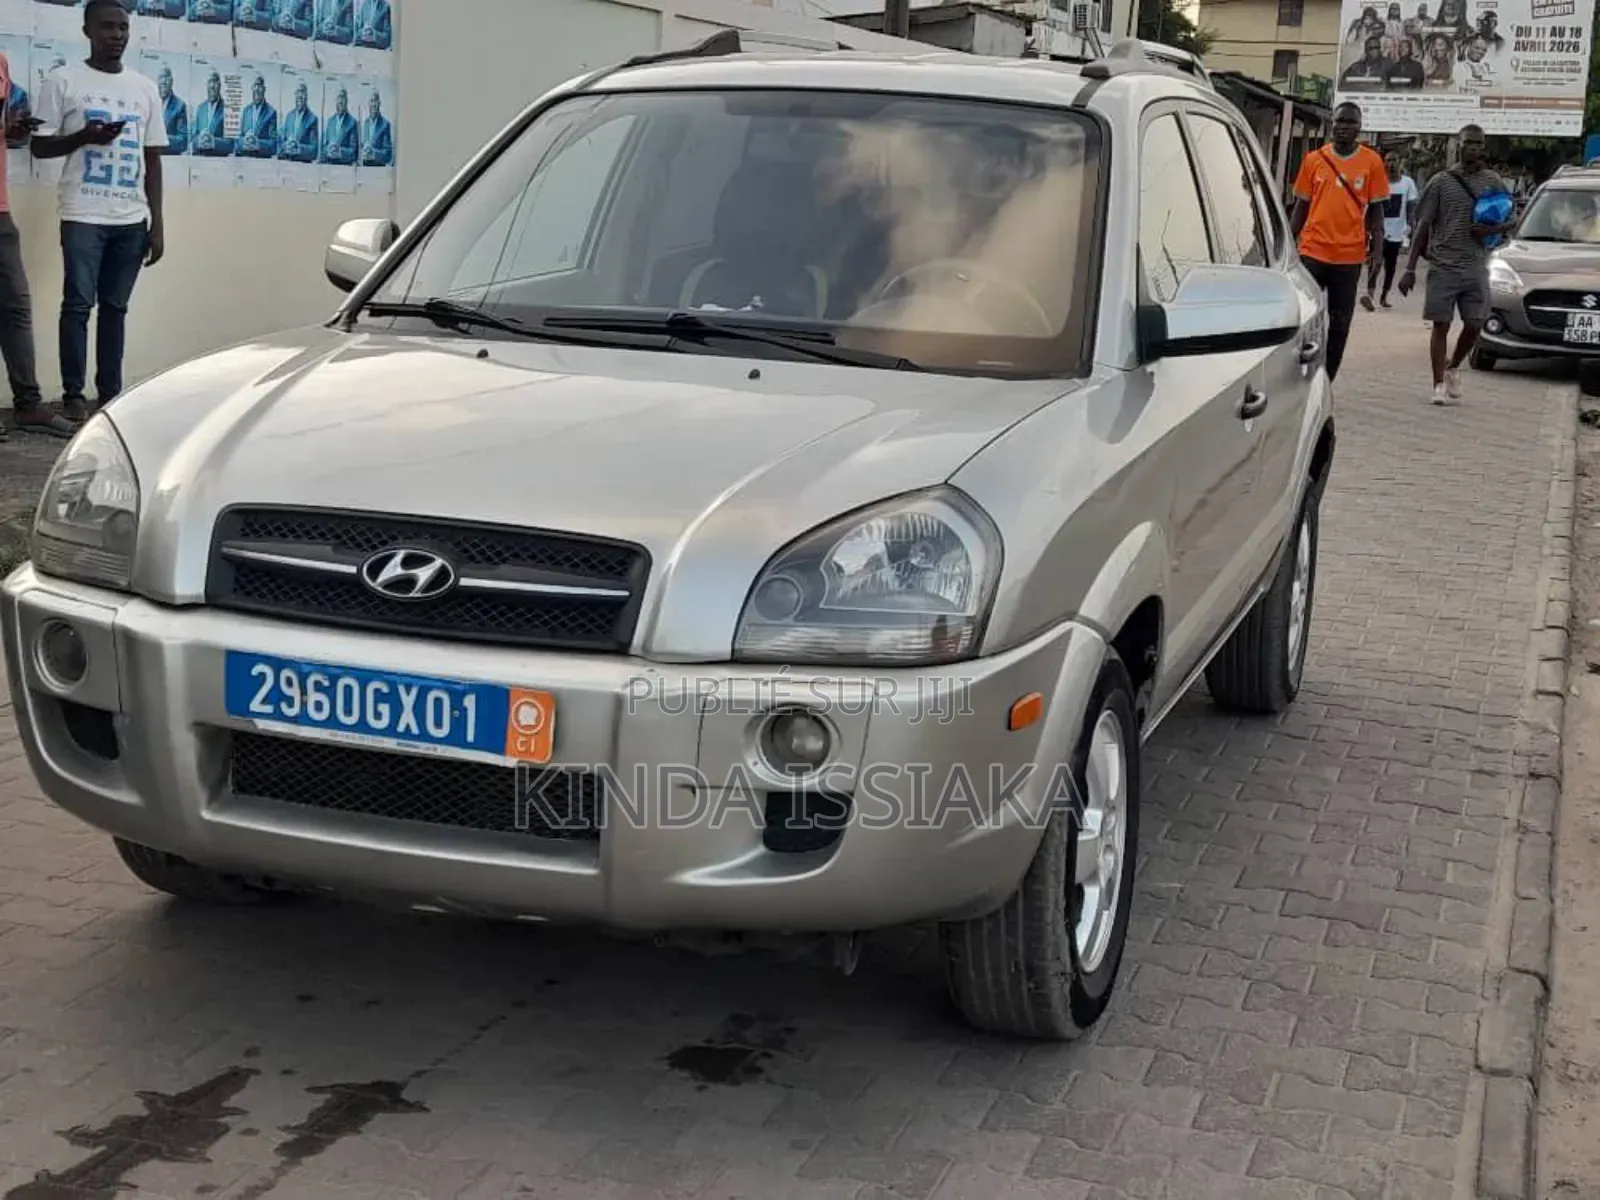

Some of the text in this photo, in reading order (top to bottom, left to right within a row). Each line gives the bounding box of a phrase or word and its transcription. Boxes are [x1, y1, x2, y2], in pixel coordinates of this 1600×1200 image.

[1515, 25, 1531, 38] DU
[1550, 25, 1566, 38] AU
[1514, 40, 1580, 53] AVRIL 2026
[1577, 316, 1592, 328] AA
[248, 661, 478, 744] 2960GX01
[516, 736, 536, 753] CI
